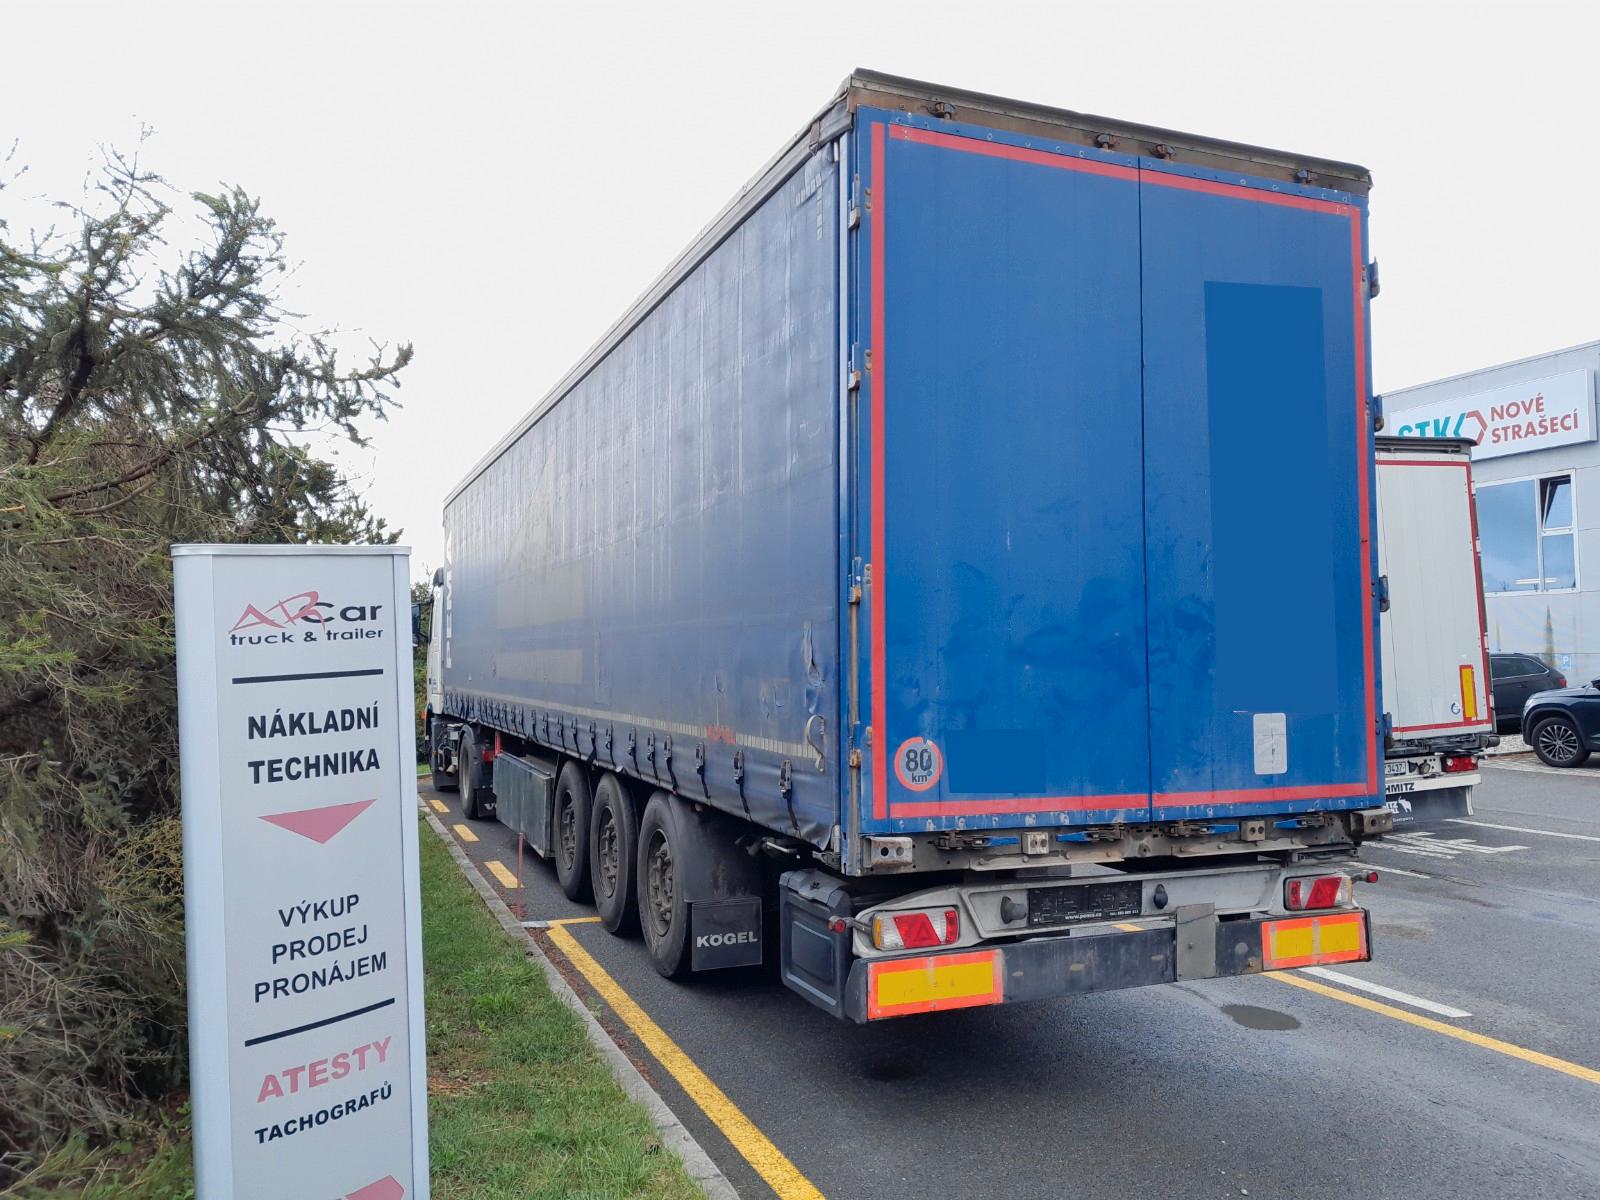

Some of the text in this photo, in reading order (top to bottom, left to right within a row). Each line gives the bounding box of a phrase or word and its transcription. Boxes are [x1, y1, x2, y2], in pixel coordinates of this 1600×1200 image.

[1490, 392, 1545, 422] NOVÉ
[1491, 408, 1579, 444] STRAŠECÍ
[230, 628, 384, 646] truck & trailer
[247, 701, 379, 740] NÁKLADNÍ
[247, 748, 381, 785] TECHNIKA
[905, 749, 932, 772] 80
[911, 773, 928, 783] km
[1385, 782, 1415, 793] HMITZ
[278, 894, 360, 927] VÝKUP
[272, 924, 368, 965] PRODEJ
[696, 931, 759, 948] KÖGEL
[254, 952, 387, 1003] PRONÁJEM
[257, 1036, 393, 1104] ATESTY
[254, 1080, 393, 1144] TACHOGRAFŮ
